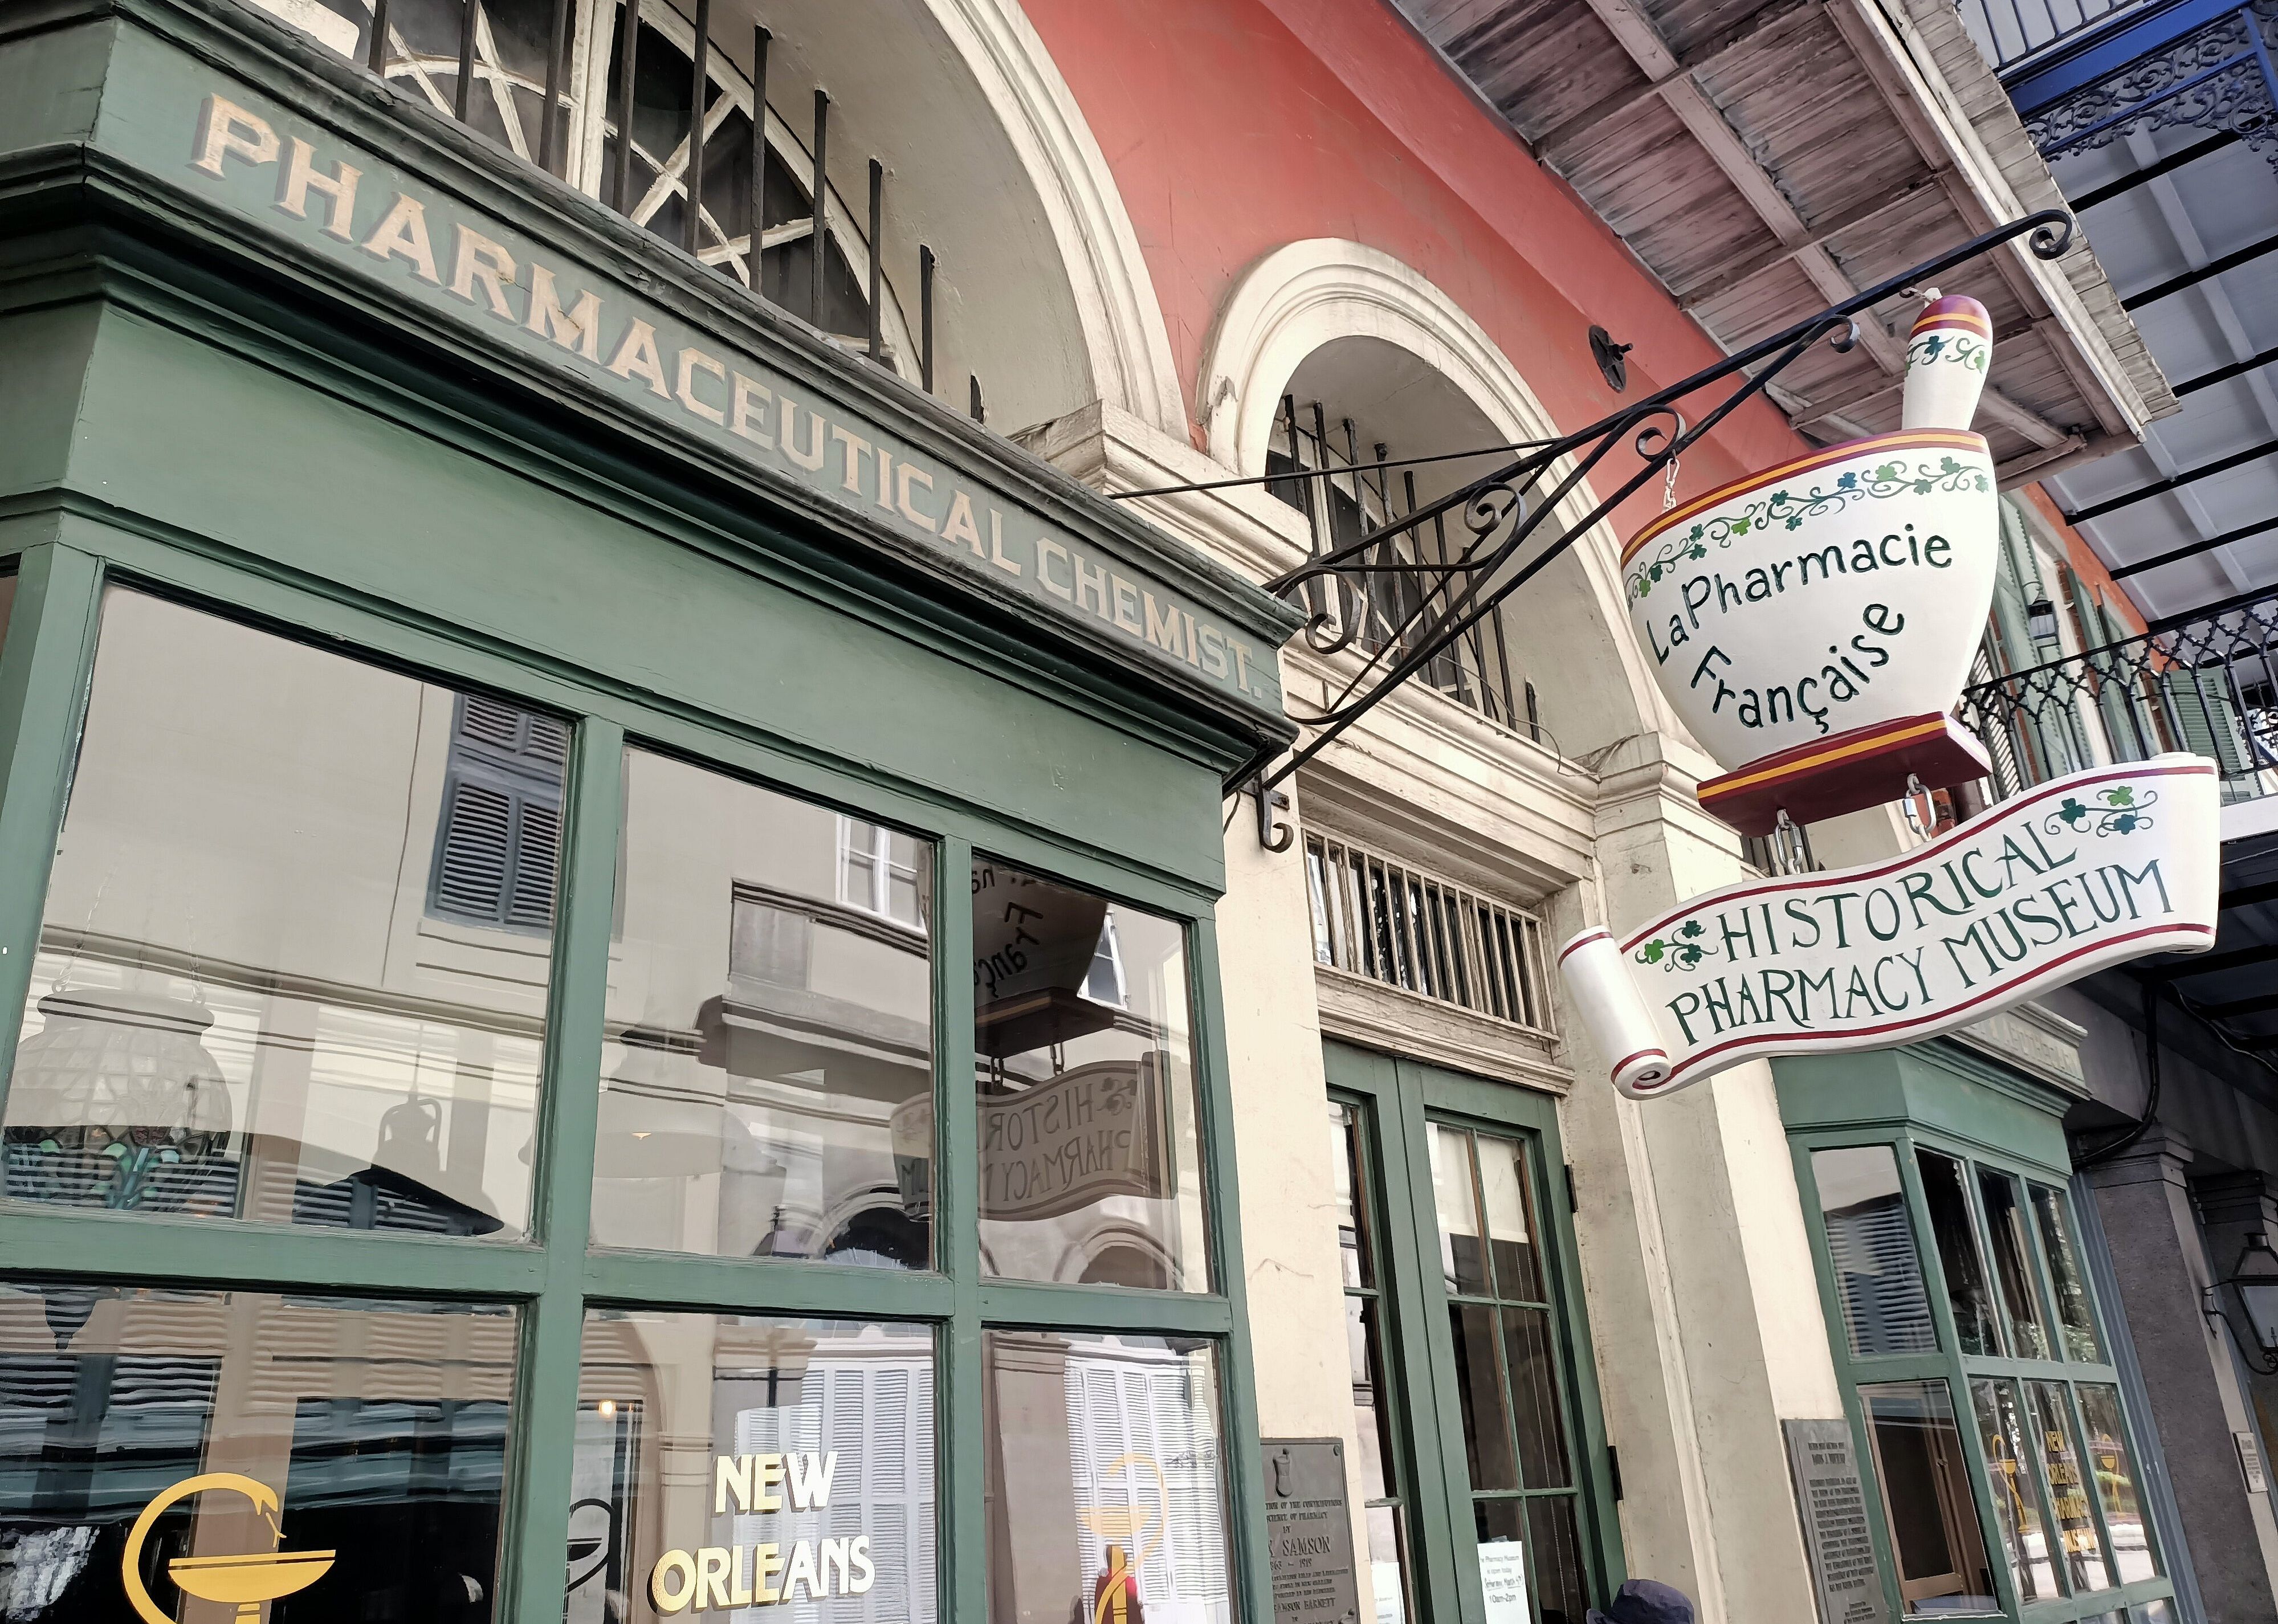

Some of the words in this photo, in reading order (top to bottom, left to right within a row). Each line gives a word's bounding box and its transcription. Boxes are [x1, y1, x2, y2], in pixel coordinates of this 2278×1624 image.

[188, 92, 1021, 577] PHARMACEUTICAL
[1034, 536, 1261, 699] CHEMIST.
[1647, 613, 1689, 666] La
[1682, 523, 1953, 631] Pharmacie
[1690, 602, 1906, 734] Française
[1665, 946, 1934, 1047] PHARMACY
[1941, 859, 2175, 990] MUSEUM
[1717, 821, 2079, 964] HISTORICAL
[714, 1451, 839, 1516] NEW
[2045, 1431, 2065, 1452] NEW
[649, 1535, 876, 1614] ORLEANS
[1282, 1536, 1331, 1556] SAMSON
